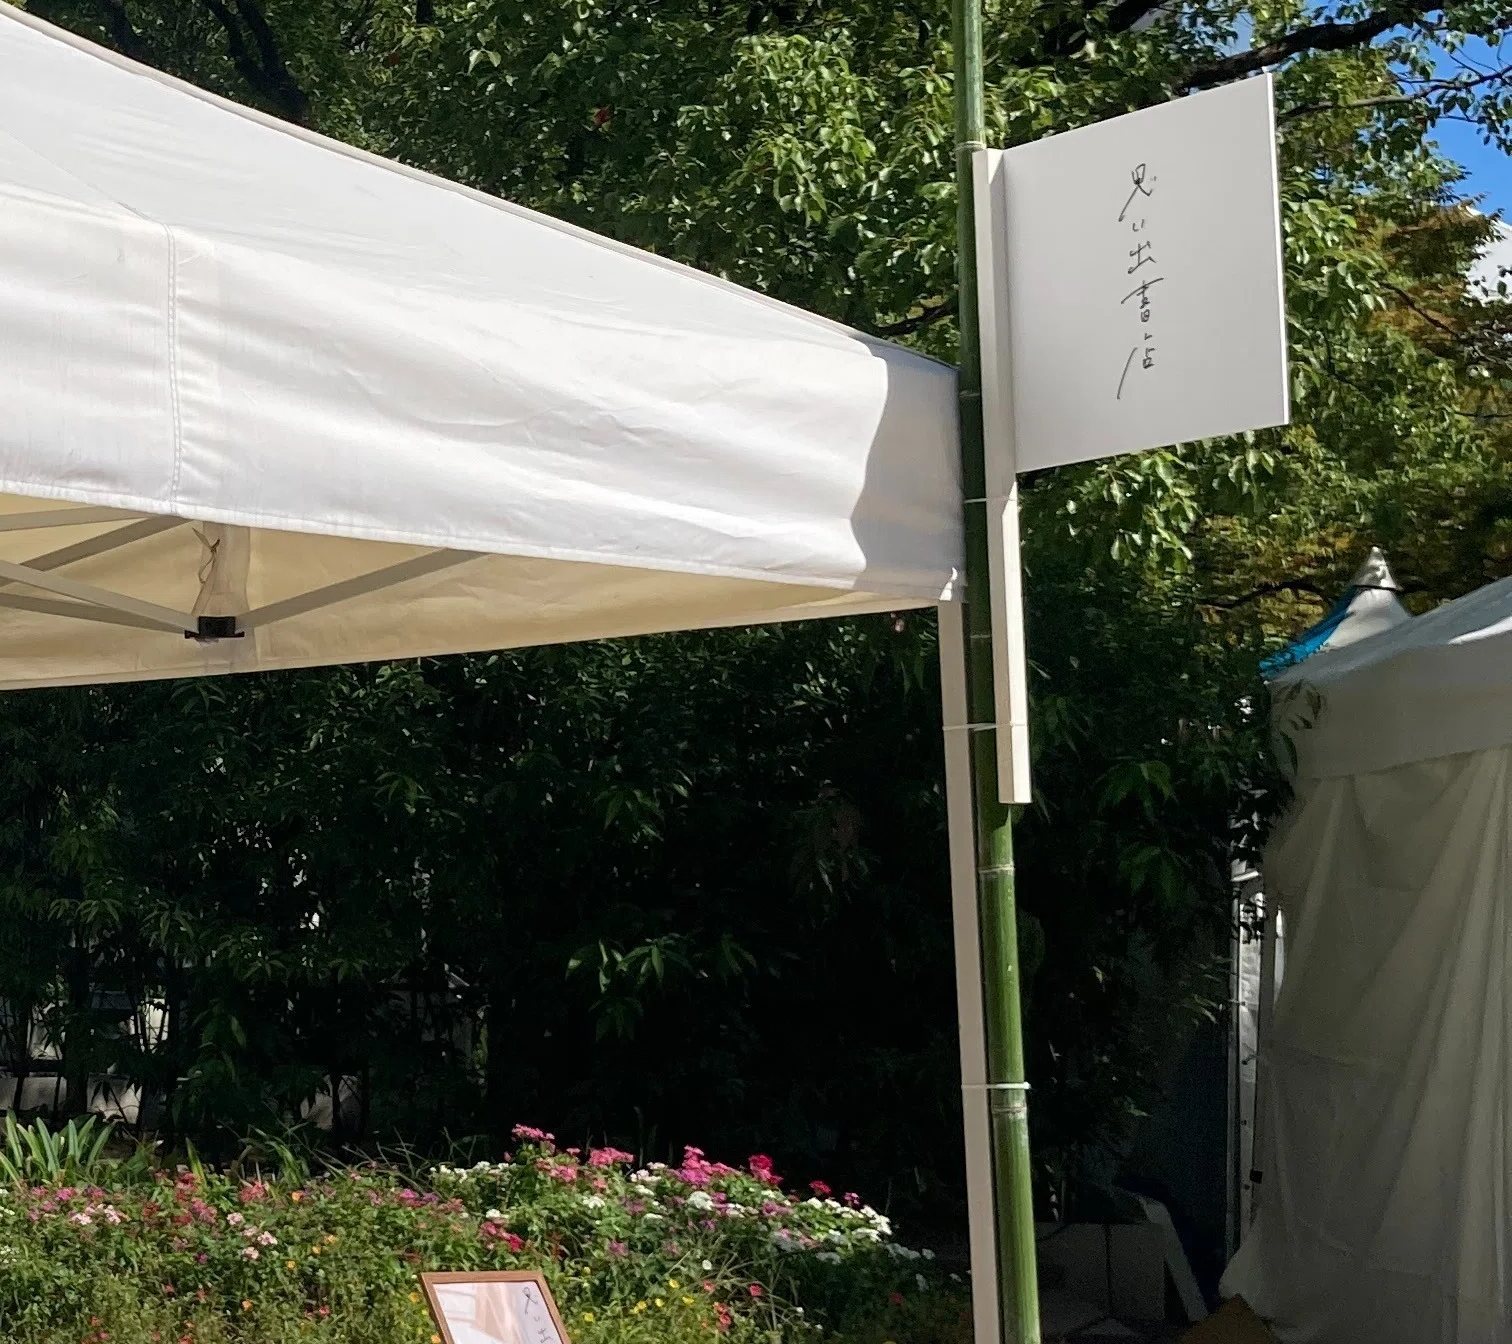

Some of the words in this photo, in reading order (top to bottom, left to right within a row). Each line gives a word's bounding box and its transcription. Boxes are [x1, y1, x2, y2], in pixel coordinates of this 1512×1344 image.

[1116, 162, 1165, 401] 思い出書店
